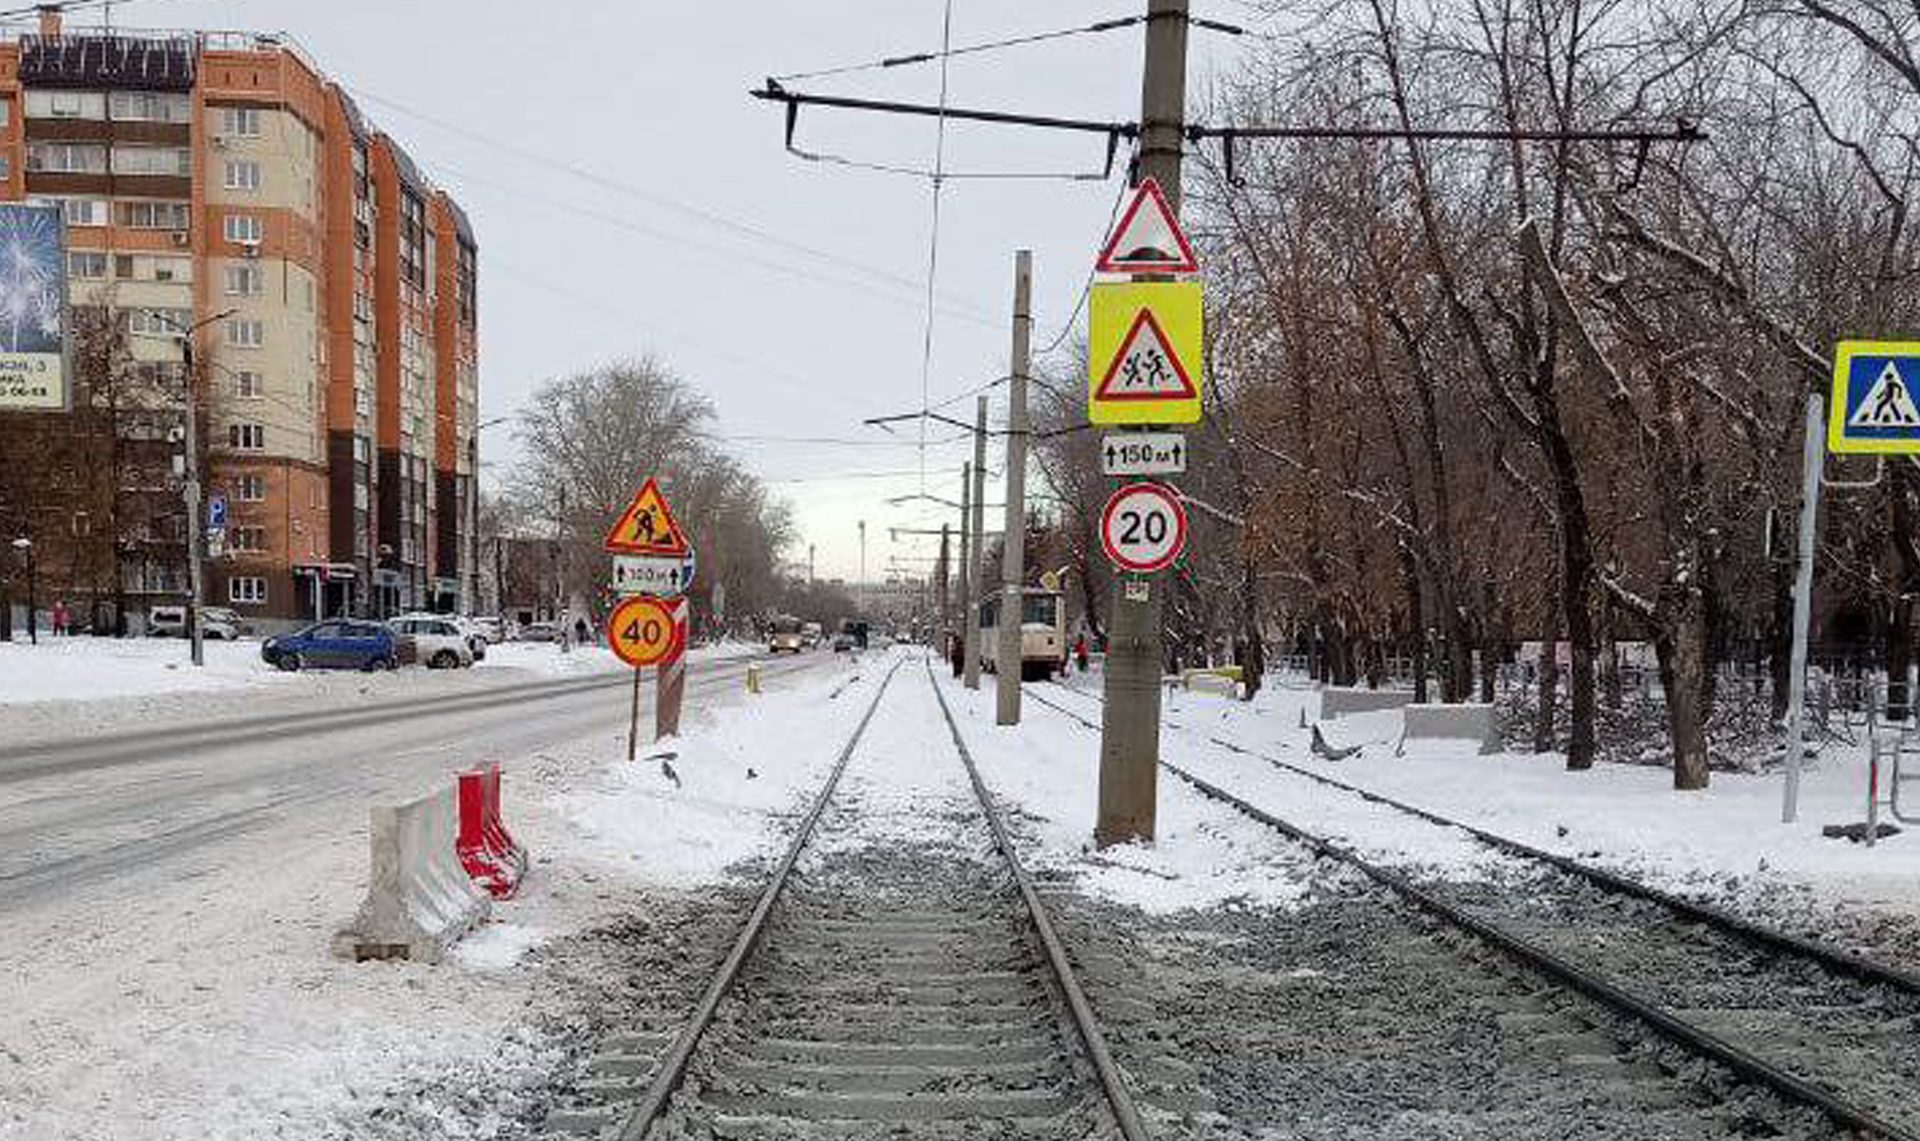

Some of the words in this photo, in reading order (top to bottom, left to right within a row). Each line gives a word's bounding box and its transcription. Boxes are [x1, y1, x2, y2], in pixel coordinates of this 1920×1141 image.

[1120, 443, 1154, 463] 150
[1120, 510, 1167, 544] 20
[620, 618, 661, 646] 40
